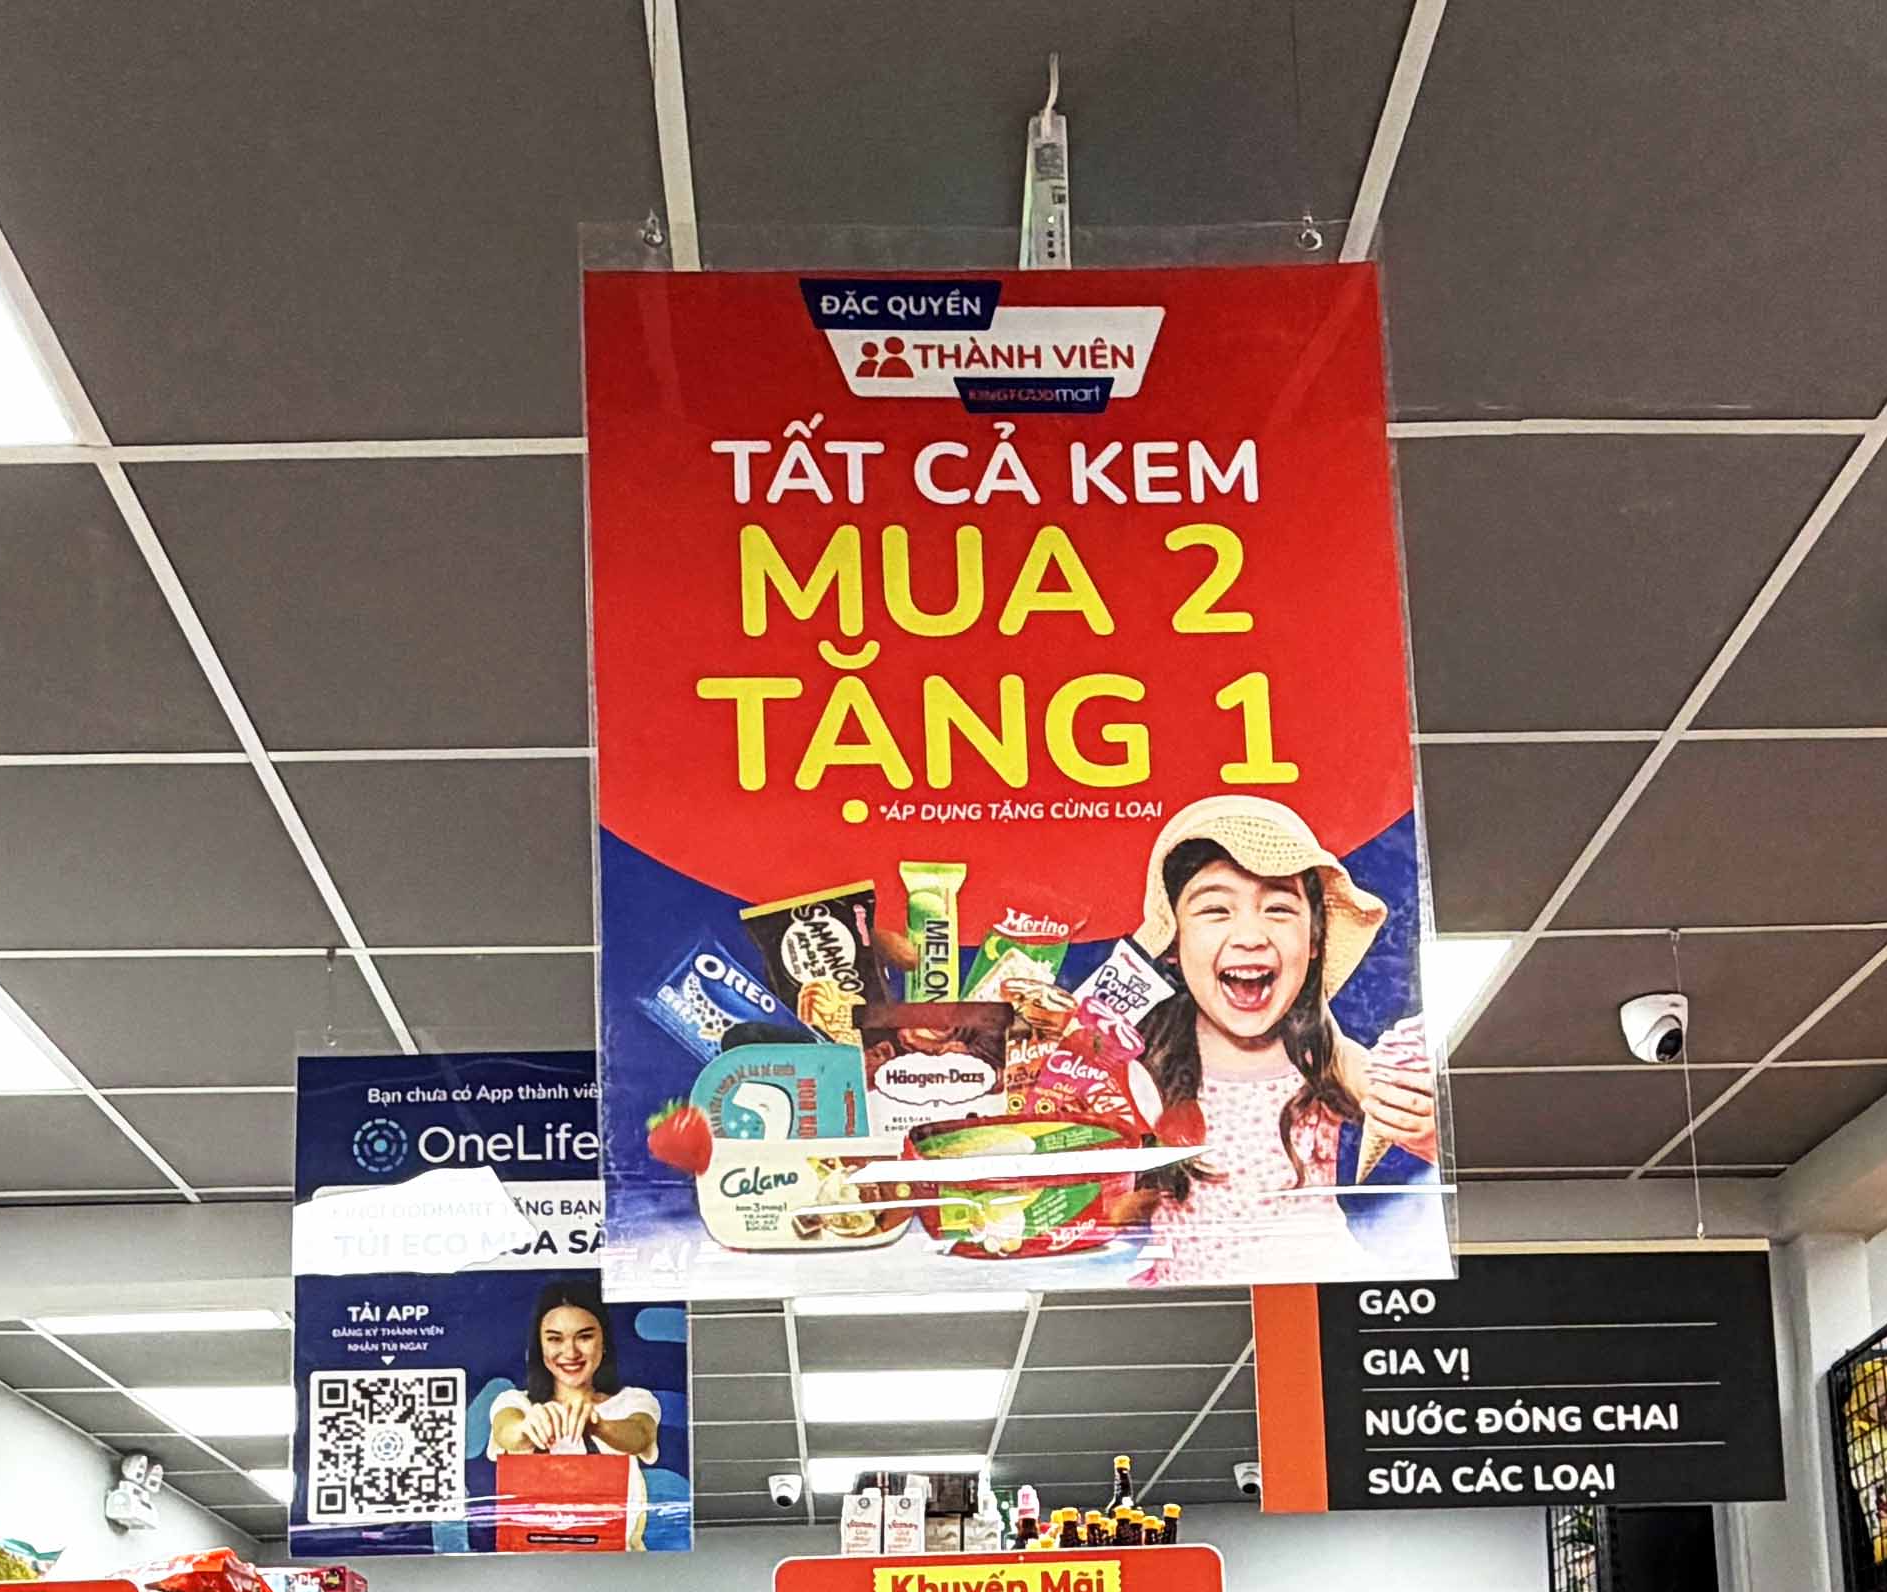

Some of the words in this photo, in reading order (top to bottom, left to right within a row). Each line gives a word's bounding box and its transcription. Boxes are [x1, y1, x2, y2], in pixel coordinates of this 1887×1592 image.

[820, 292, 879, 321] ĐẶC
[885, 286, 982, 321] QUYỀN
[913, 335, 1045, 372] THÀNH
[1053, 333, 1135, 371] VIÊN
[711, 413, 884, 505] TẤT
[913, 422, 1042, 505] CẢ
[1069, 439, 1260, 505] KEM
[739, 524, 1116, 639] MUA
[1164, 523, 1255, 634] 2
[697, 640, 1152, 824] TẶNG
[1215, 671, 1299, 786] 1
[920, 802, 982, 824] DỤNG
[989, 800, 1043, 822] TẶNG
[1050, 798, 1109, 819] CÙNG
[1115, 801, 1162, 821] LOẠI
[1000, 907, 1069, 936] Merino
[924, 919, 950, 1002] MELON
[693, 953, 776, 1014] OREO
[368, 1087, 403, 1109] Bạn
[406, 1087, 448, 1103] chưa
[452, 1085, 474, 1103] có
[477, 1085, 513, 1105] App
[517, 1084, 569, 1101] thành
[573, 1084, 602, 1100] viê
[418, 1122, 599, 1163] OneLife
[720, 1166, 799, 1198] Celano
[559, 1199, 602, 1221] BẠN
[347, 1301, 381, 1323] TẢI
[386, 1304, 429, 1322] APP
[1358, 1287, 1436, 1323] GẠO
[1362, 1348, 1426, 1376] GIA
[1434, 1347, 1471, 1381] VỊ
[1366, 1399, 1467, 1436] NƯỚC
[1476, 1398, 1582, 1435] ĐÓNG
[1593, 1403, 1679, 1432] CHAI
[1368, 1459, 1442, 1496] SỮA
[1452, 1457, 1523, 1493] CÁC
[1534, 1463, 1616, 1498] LOẠI
